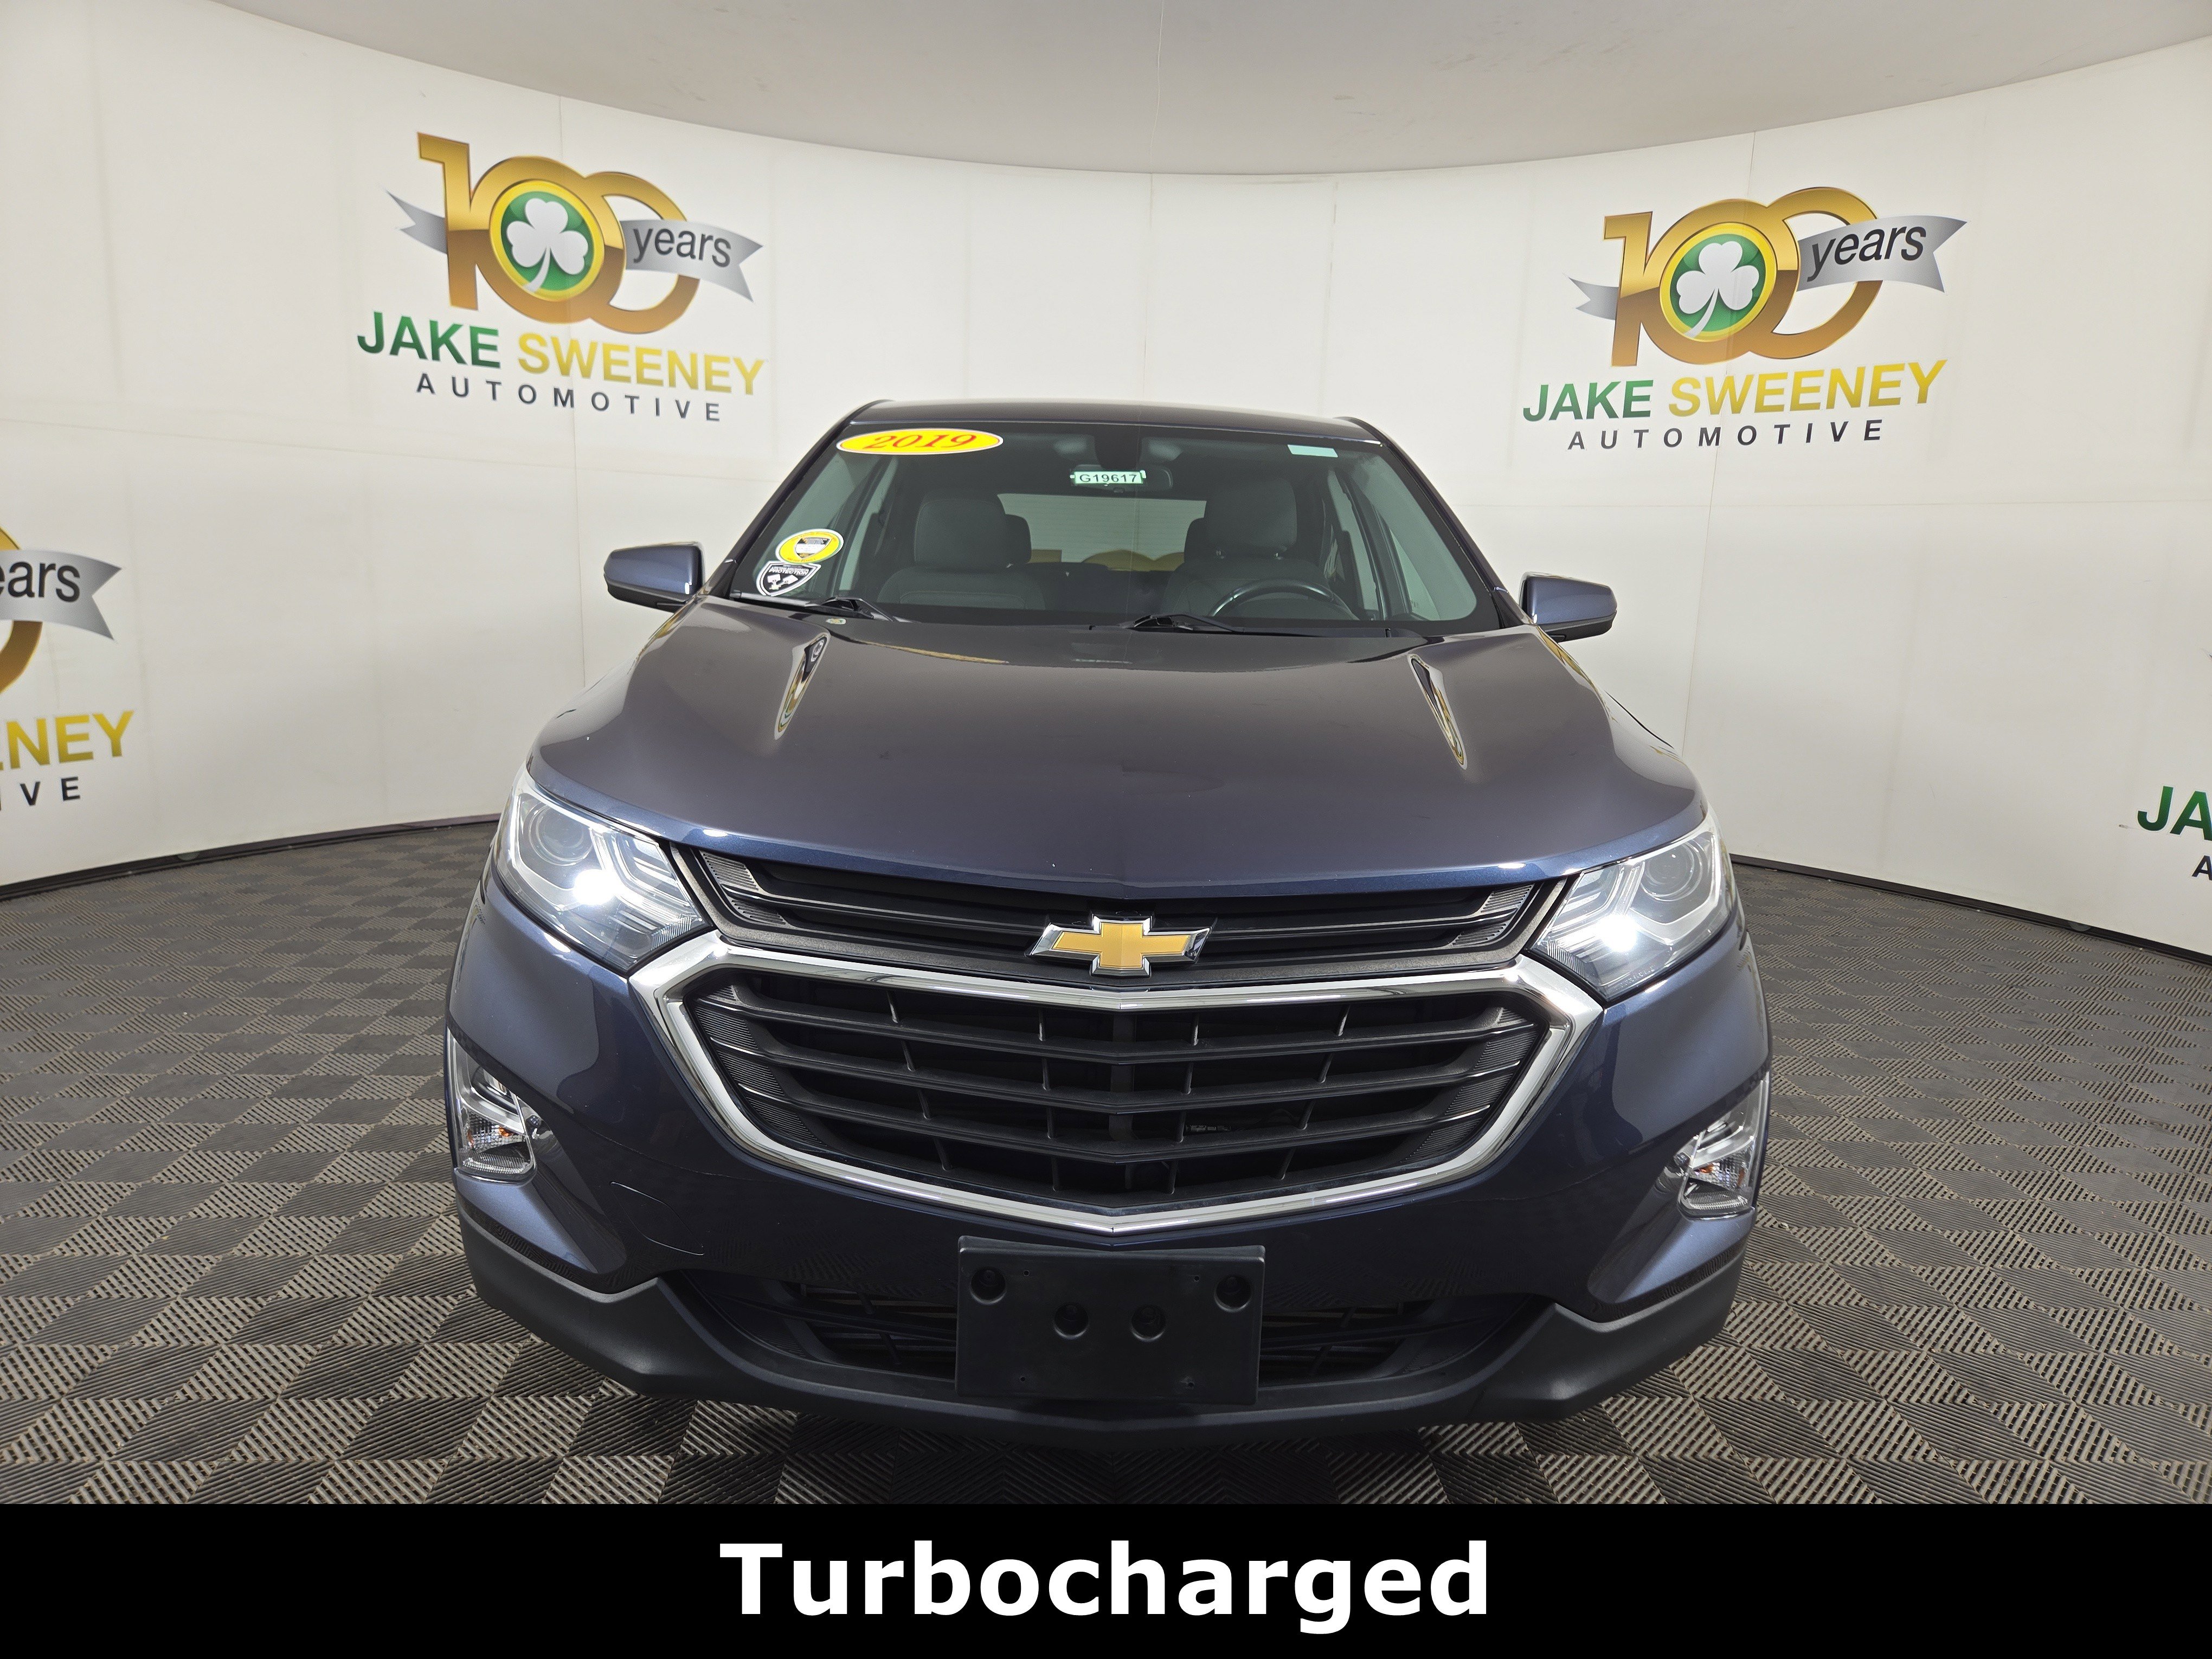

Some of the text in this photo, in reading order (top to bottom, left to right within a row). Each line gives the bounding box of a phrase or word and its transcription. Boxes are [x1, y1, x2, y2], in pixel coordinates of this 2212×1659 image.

[416, 132, 731, 334] 100 years
[1602, 187, 1927, 368] 100 years
[357, 311, 764, 395] JAKE SWEENEY
[416, 372, 720, 422] AUTOMOTIVE
[1522, 358, 1948, 421] JAKE SWEENEY
[863, 434, 977, 449] 2019
[1567, 419, 1883, 451] AUTOMOTIVE
[1079, 474, 1137, 483] G19617
[0, 561, 80, 602] ars
[0, 710, 134, 770] NEY
